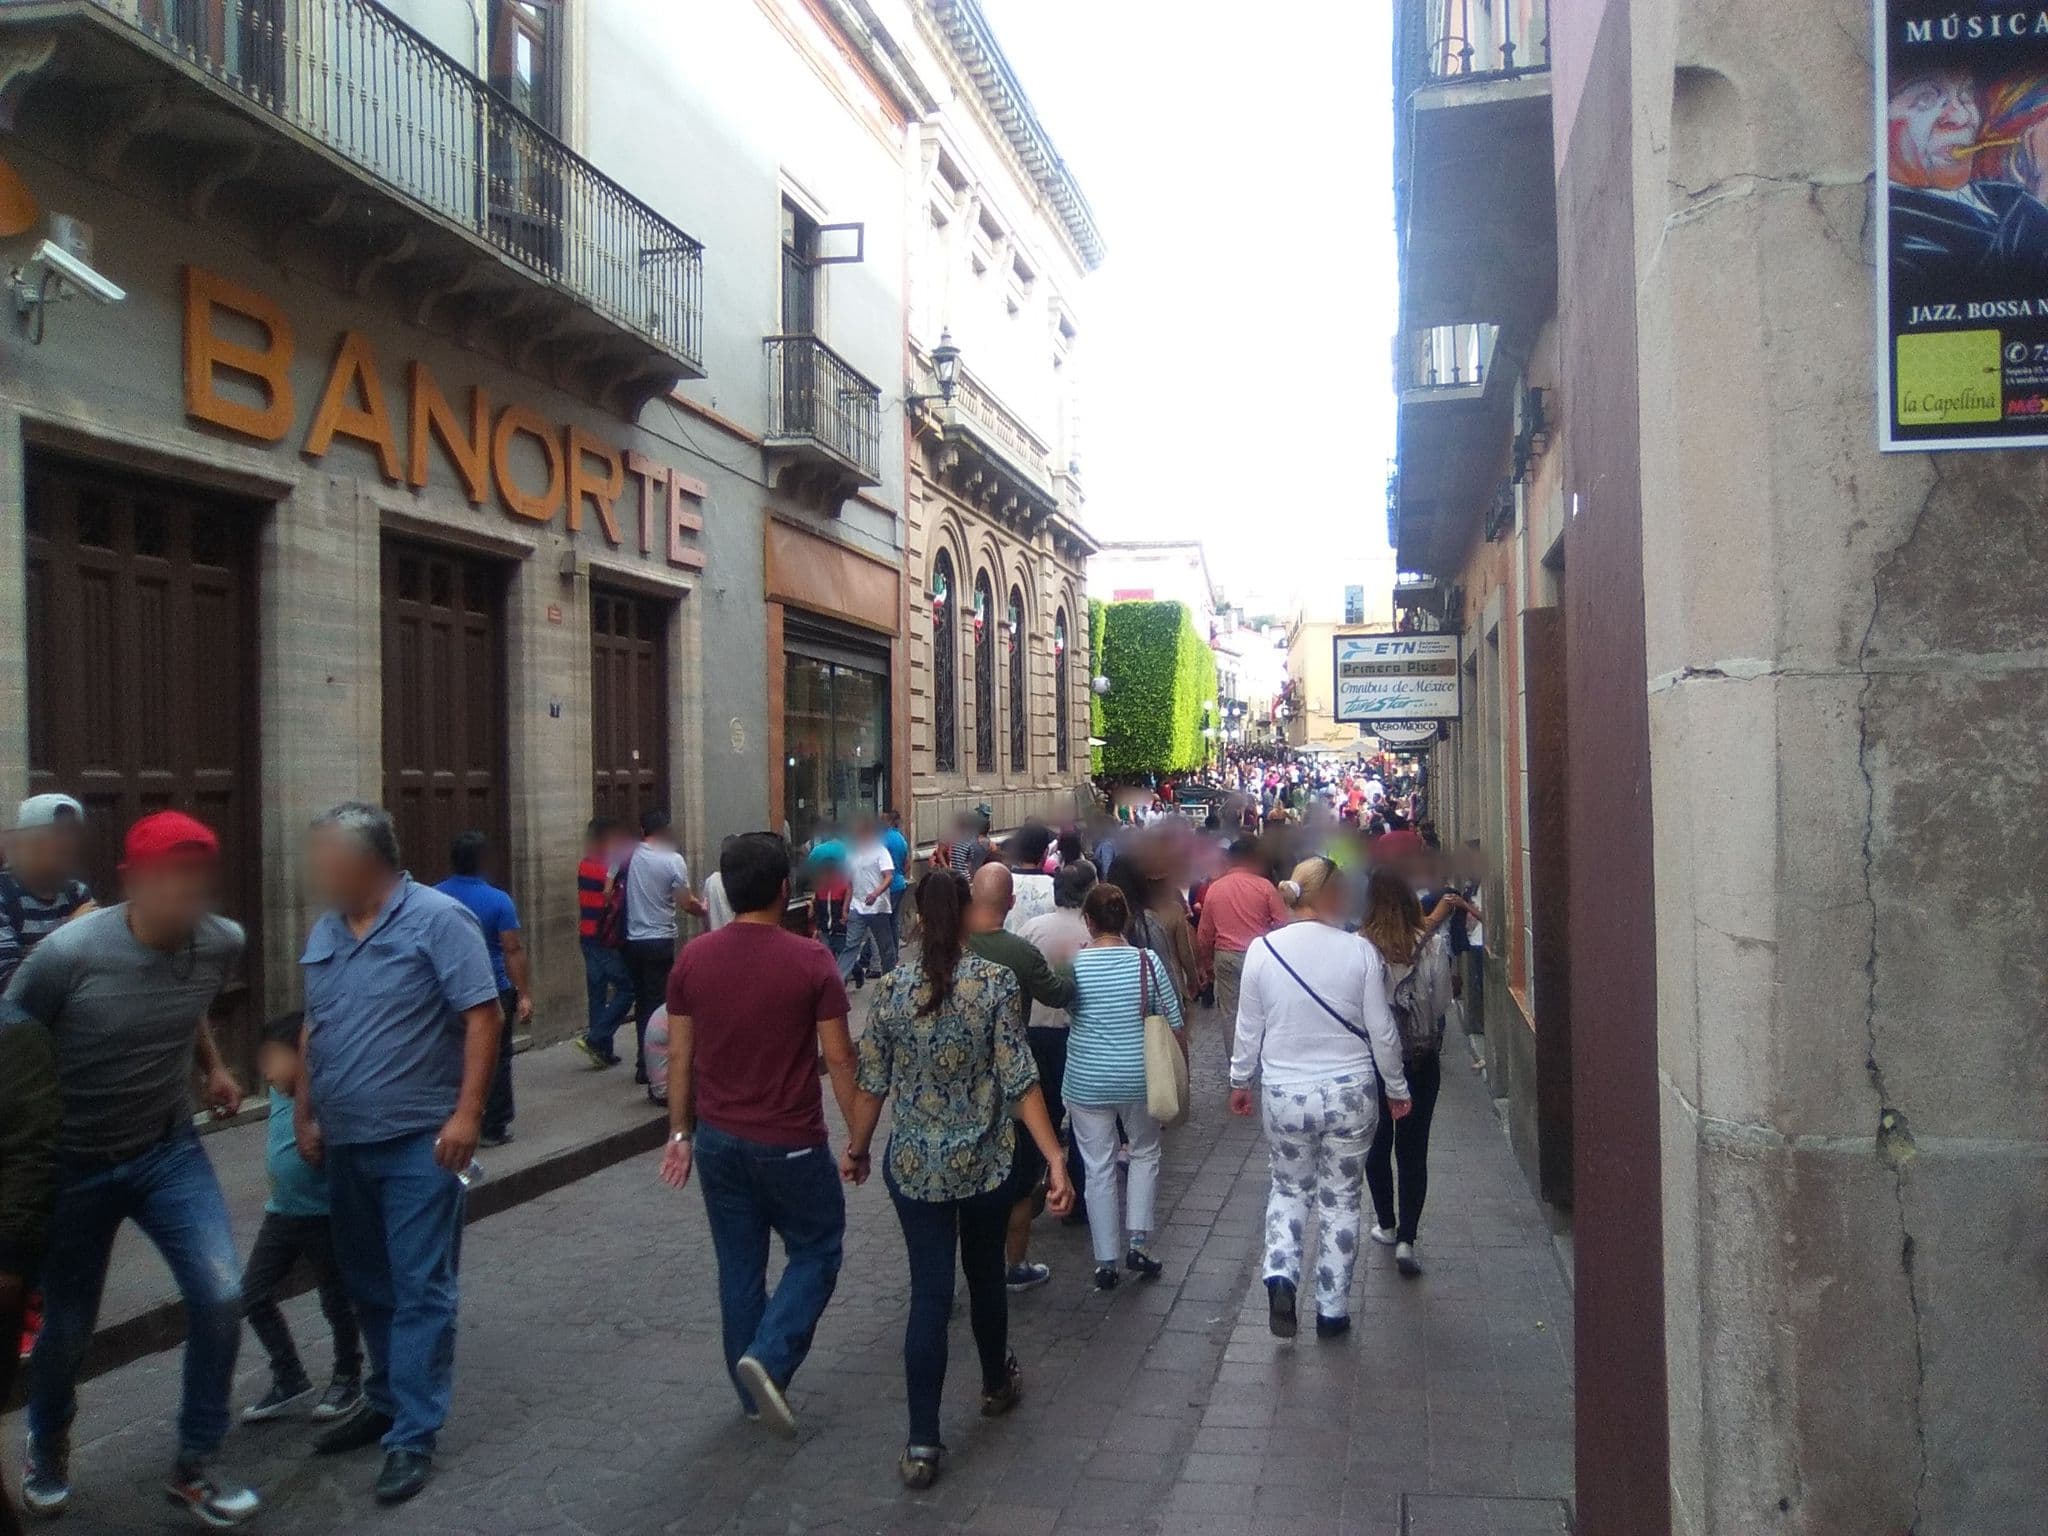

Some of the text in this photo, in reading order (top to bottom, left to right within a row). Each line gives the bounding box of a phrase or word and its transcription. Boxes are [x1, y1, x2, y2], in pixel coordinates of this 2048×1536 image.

[1967, 300, 2032, 319] BOSSA
[1903, 391, 1917, 413] la
[182, 263, 708, 569] BANORTE
[1374, 641, 1417, 655] ETN
[1407, 662, 1437, 673] Plus
[1392, 680, 1408, 693] de
